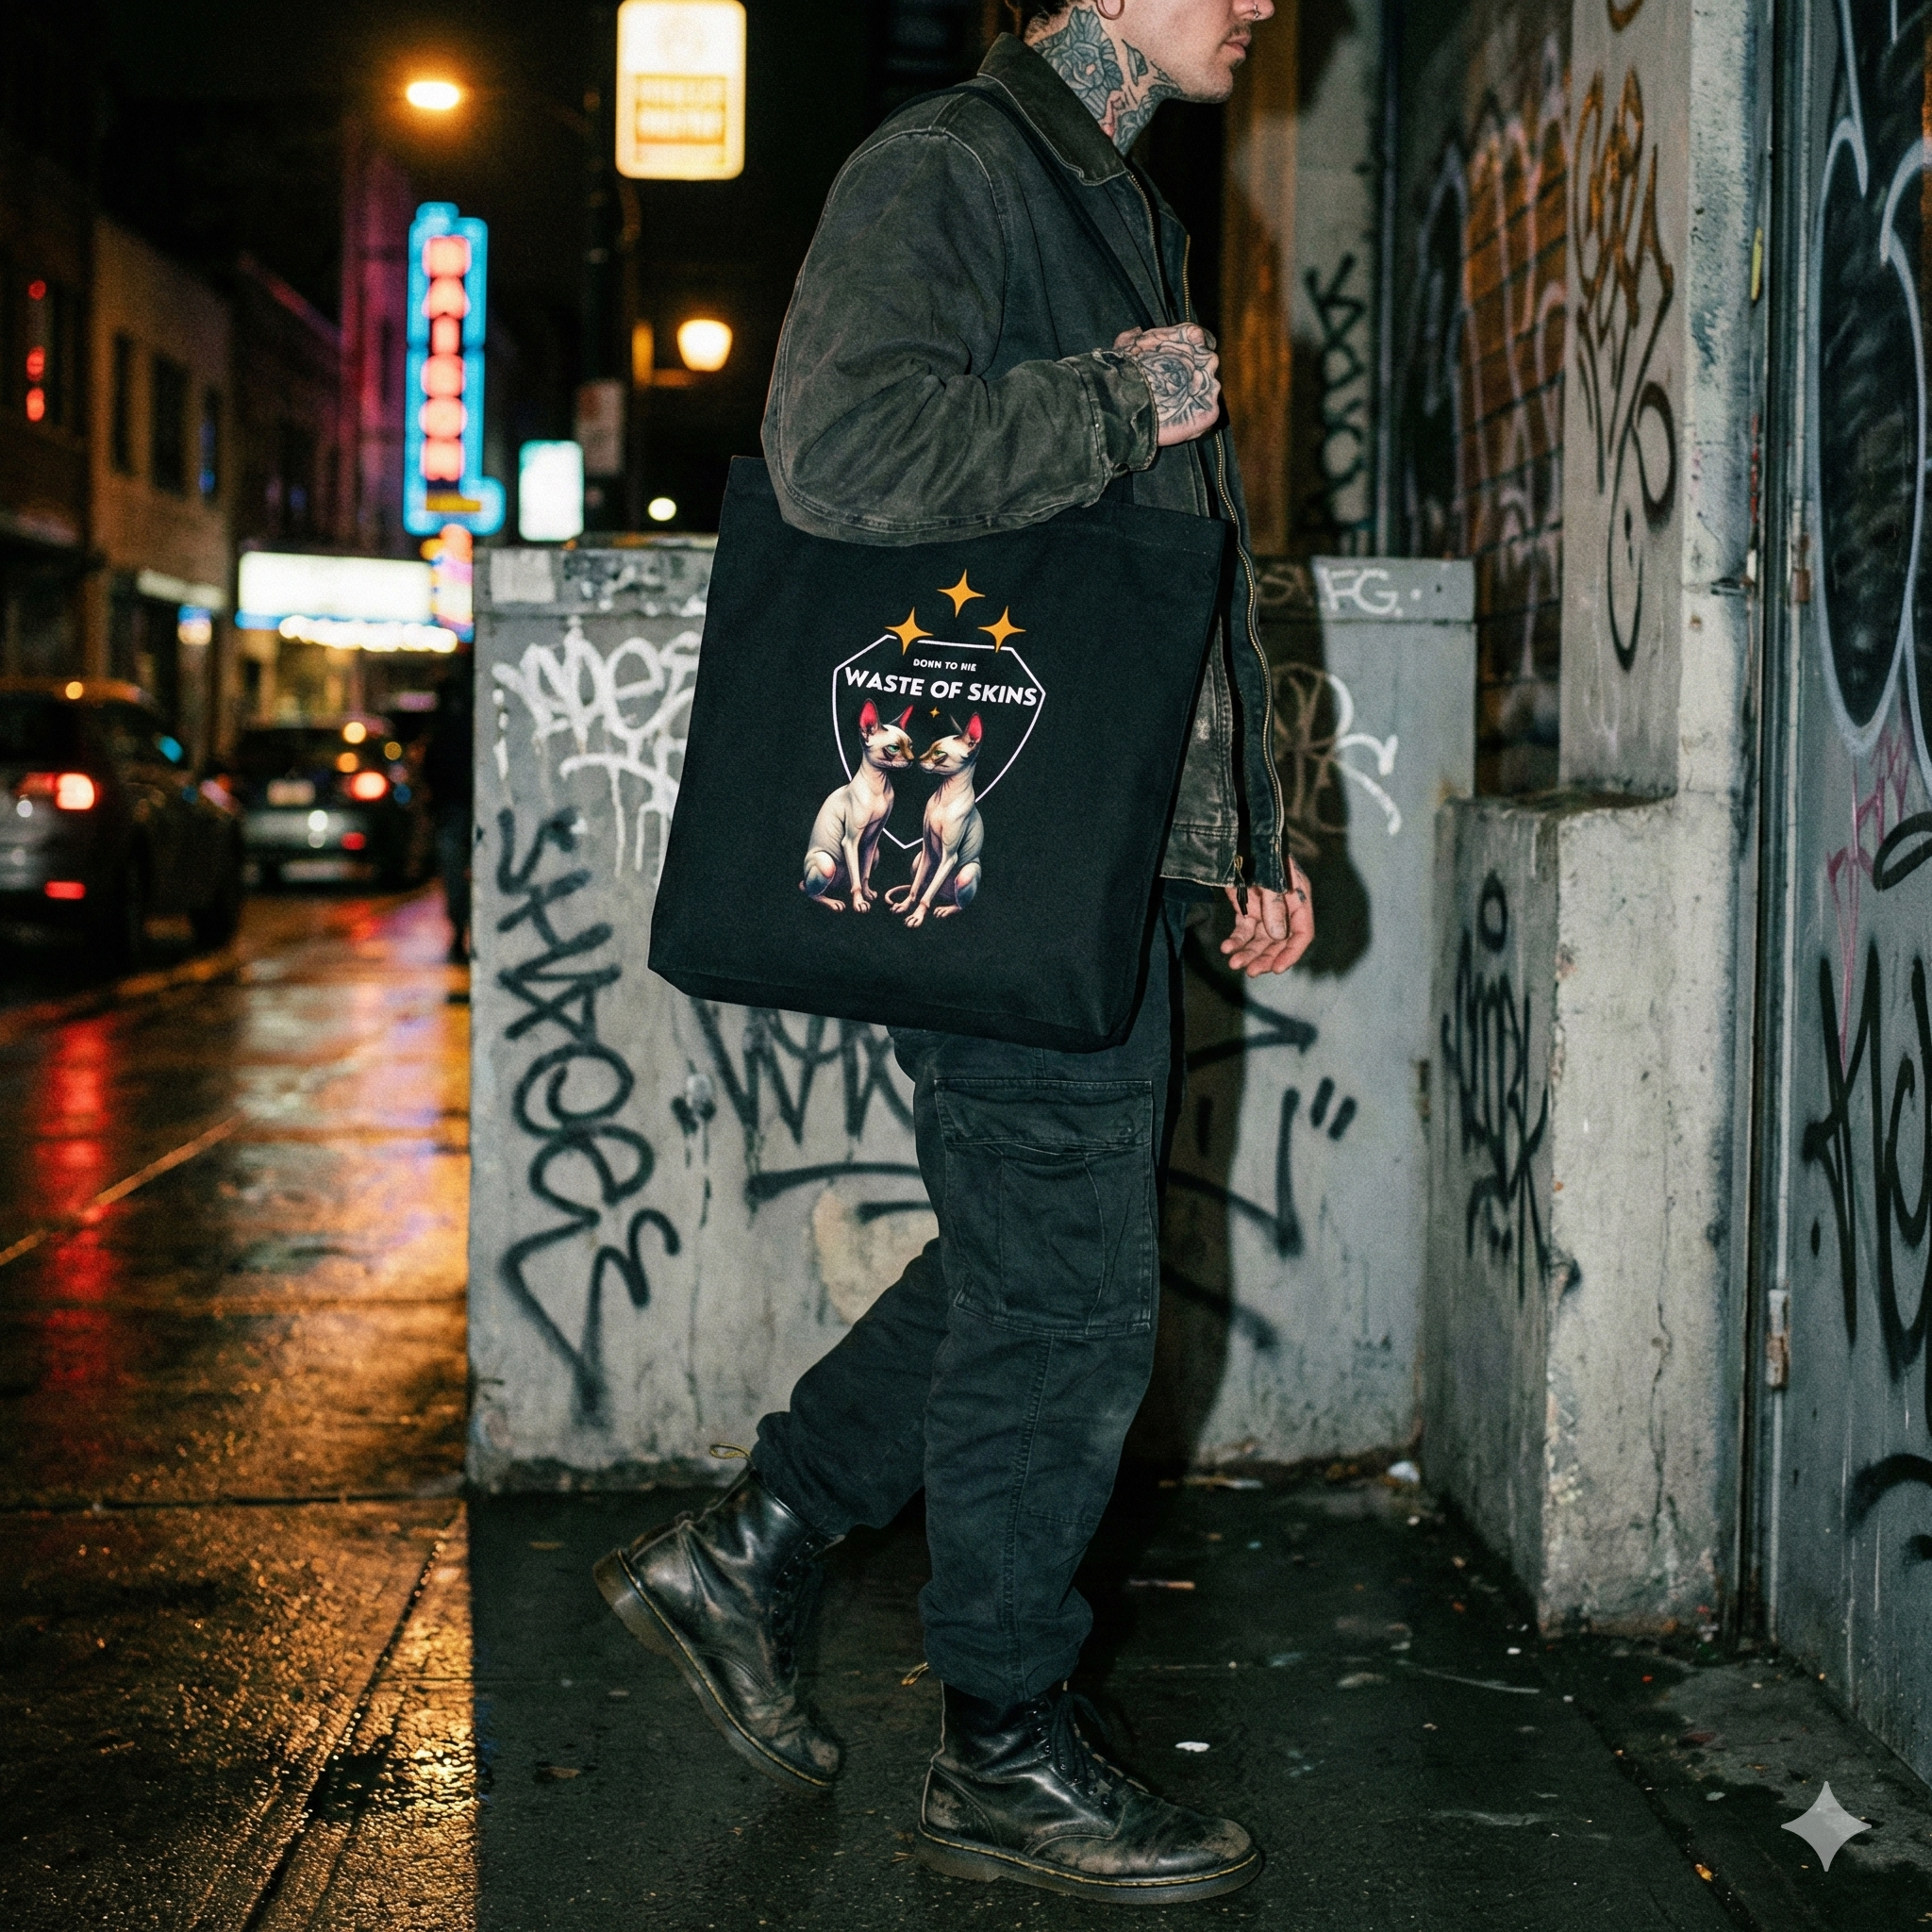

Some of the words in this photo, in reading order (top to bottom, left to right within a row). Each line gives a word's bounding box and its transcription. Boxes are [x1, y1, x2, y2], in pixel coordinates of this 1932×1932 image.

[944, 660, 958, 671] TO
[844, 666, 925, 696] WASTE
[929, 680, 964, 700] OF
[967, 682, 1038, 707] SKINS
